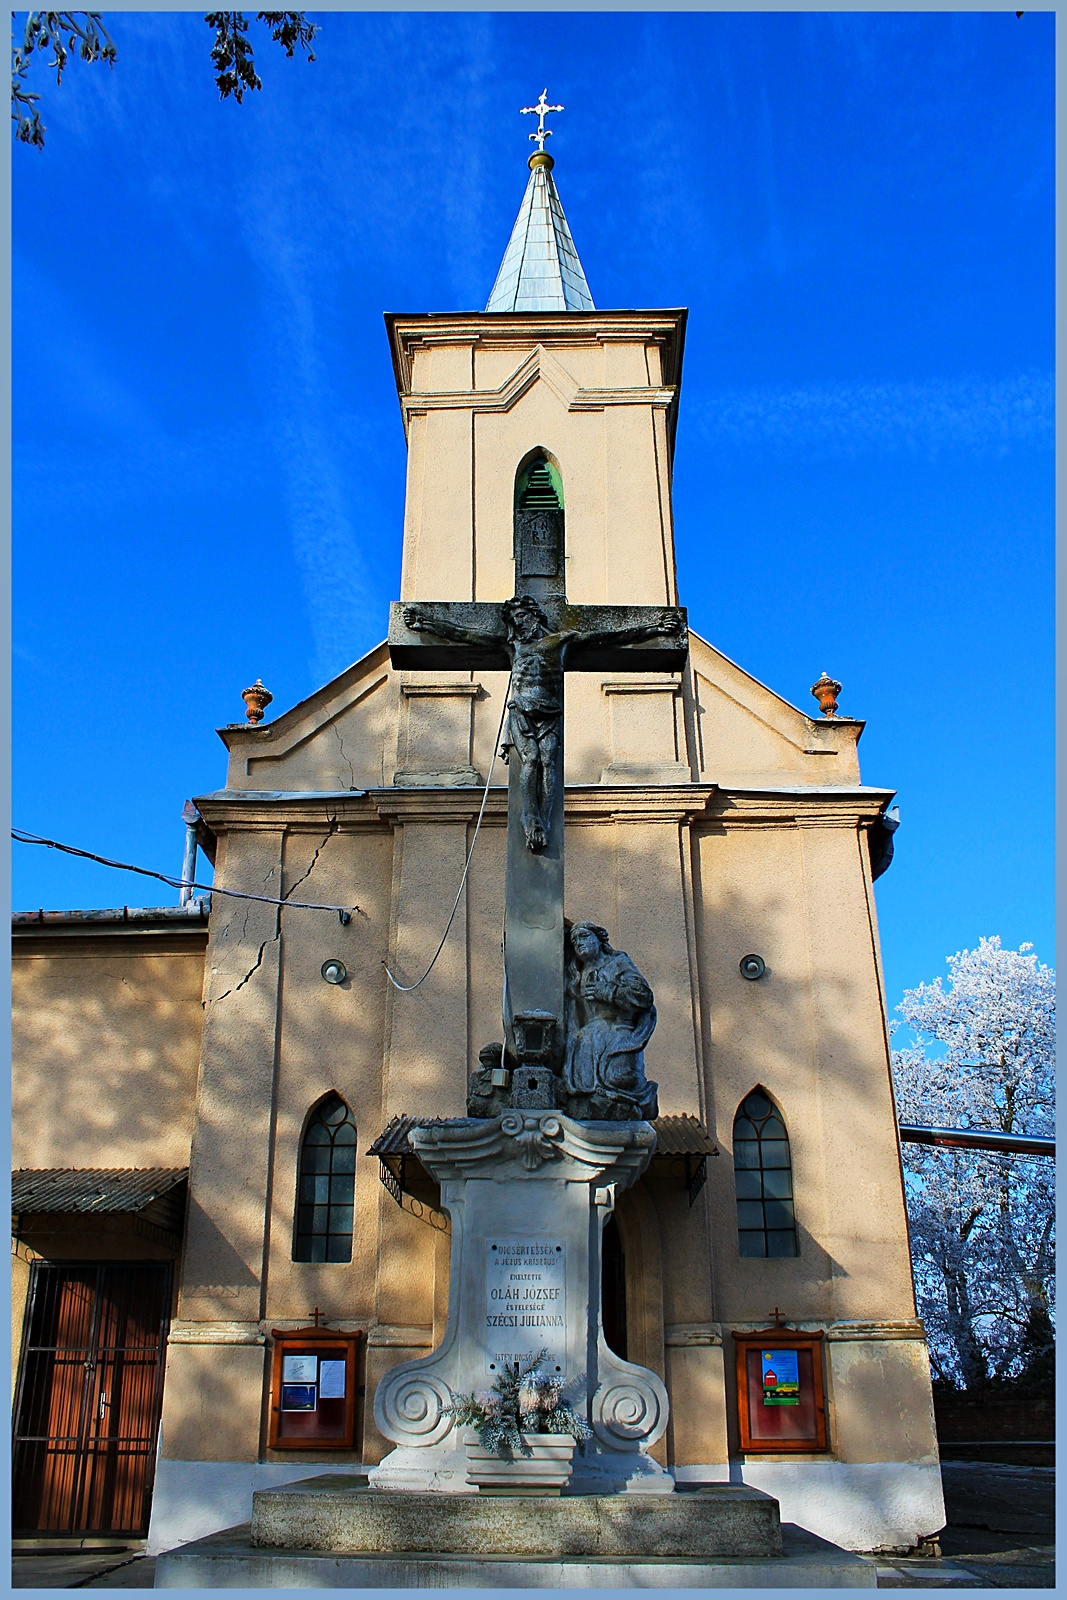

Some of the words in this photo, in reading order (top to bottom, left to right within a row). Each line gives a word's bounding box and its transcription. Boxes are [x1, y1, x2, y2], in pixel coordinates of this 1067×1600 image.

[494, 1258, 500, 1266] A
[490, 1285, 519, 1300] OLÁH
[523, 1285, 560, 1300] JÓZSEF
[506, 1302, 514, 1311] ÉS
[514, 1302, 545, 1311] FELESÉGE
[486, 1312, 518, 1327] SZÉCSI
[519, 1315, 564, 1327] JULIANNA
[495, 1353, 512, 1361] ISTEN
